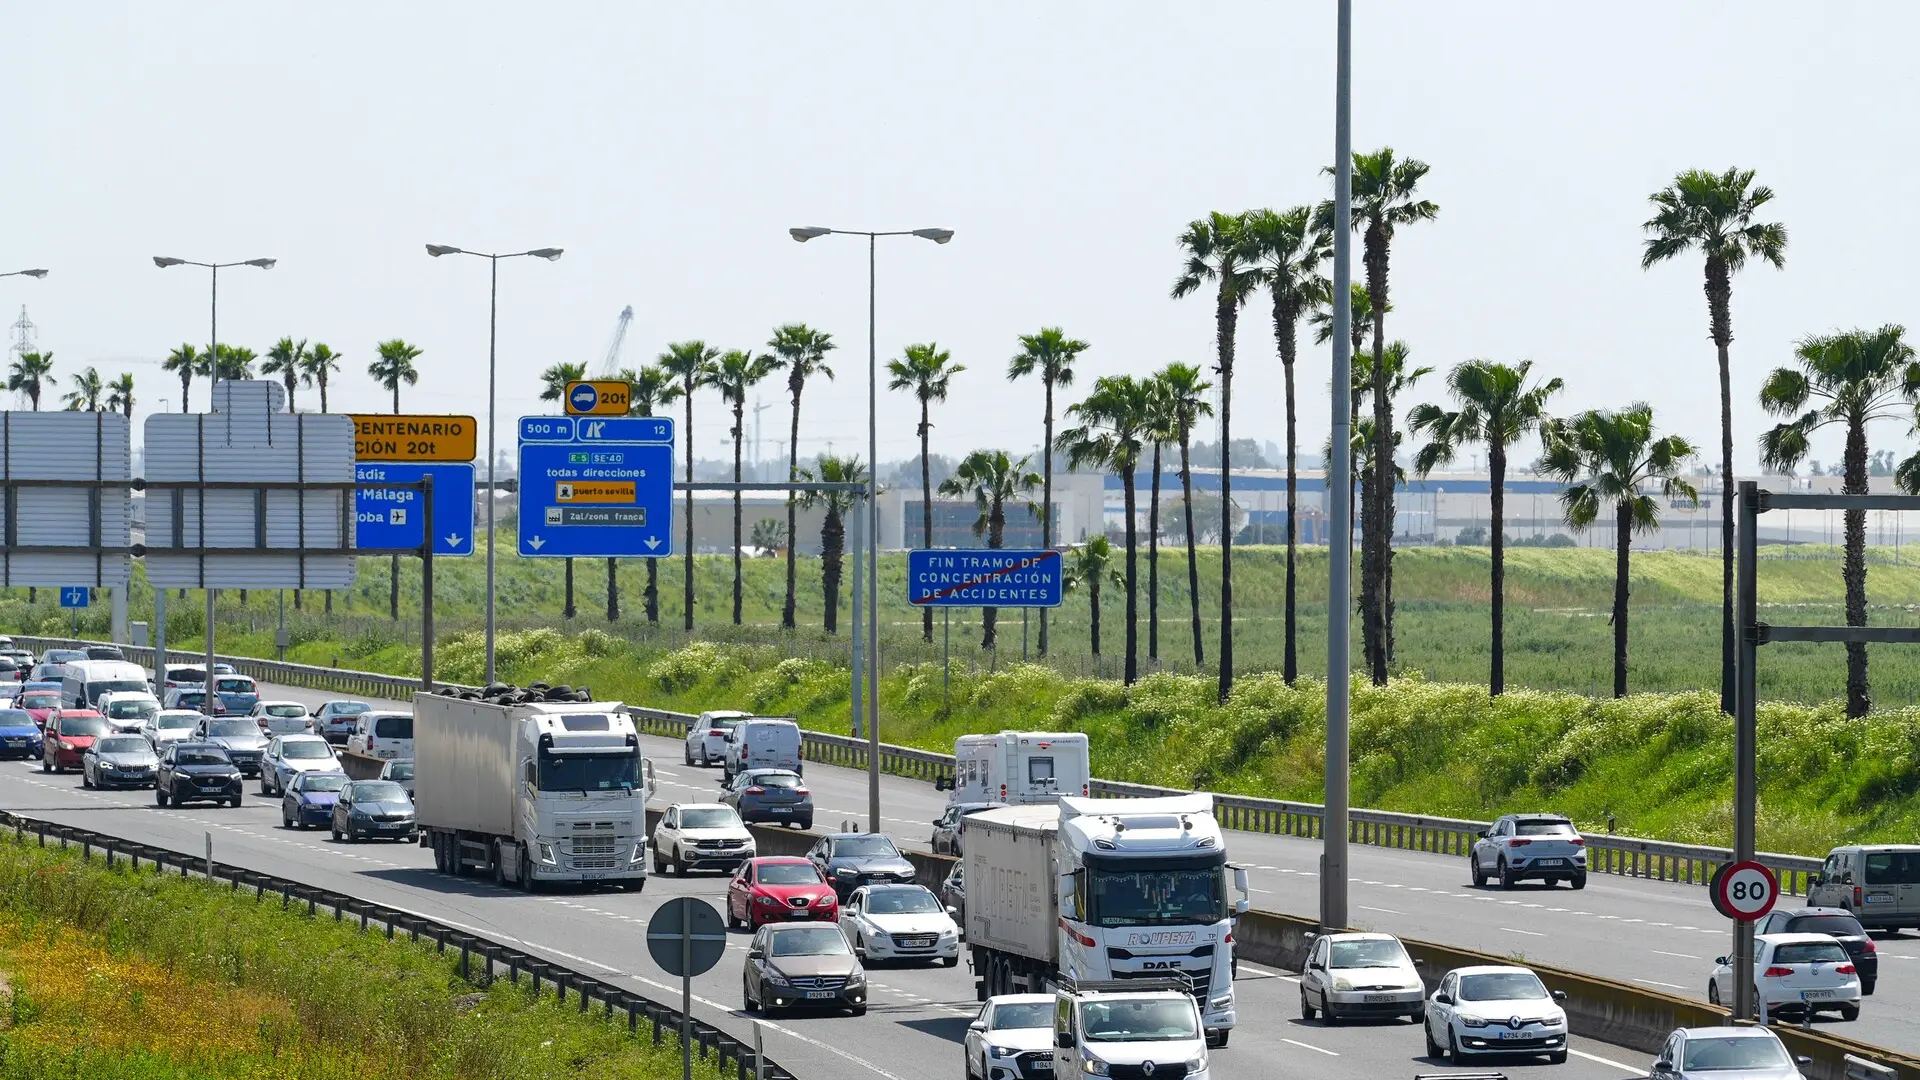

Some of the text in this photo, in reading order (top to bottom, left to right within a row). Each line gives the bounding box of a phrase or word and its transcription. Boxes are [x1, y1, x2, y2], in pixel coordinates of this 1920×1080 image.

[600, 392, 627, 404] 20t
[527, 424, 567, 434] 500 m
[653, 425, 666, 435] 12
[407, 441, 436, 454] 20t
[546, 468, 646, 477] todas direcciones
[363, 488, 414, 503] Málaga
[572, 486, 635, 497] puerto sevilla
[356, 511, 384, 522] oba
[928, 557, 1041, 568] FIN TRAMO DE
[919, 571, 1051, 584] CONCENTRACIÓN
[922, 588, 1048, 599] DE ACCIDENTES
[1733, 881, 1764, 900] 80
[1127, 931, 1197, 946] ROUPETA
[1143, 961, 1182, 970] DAF
